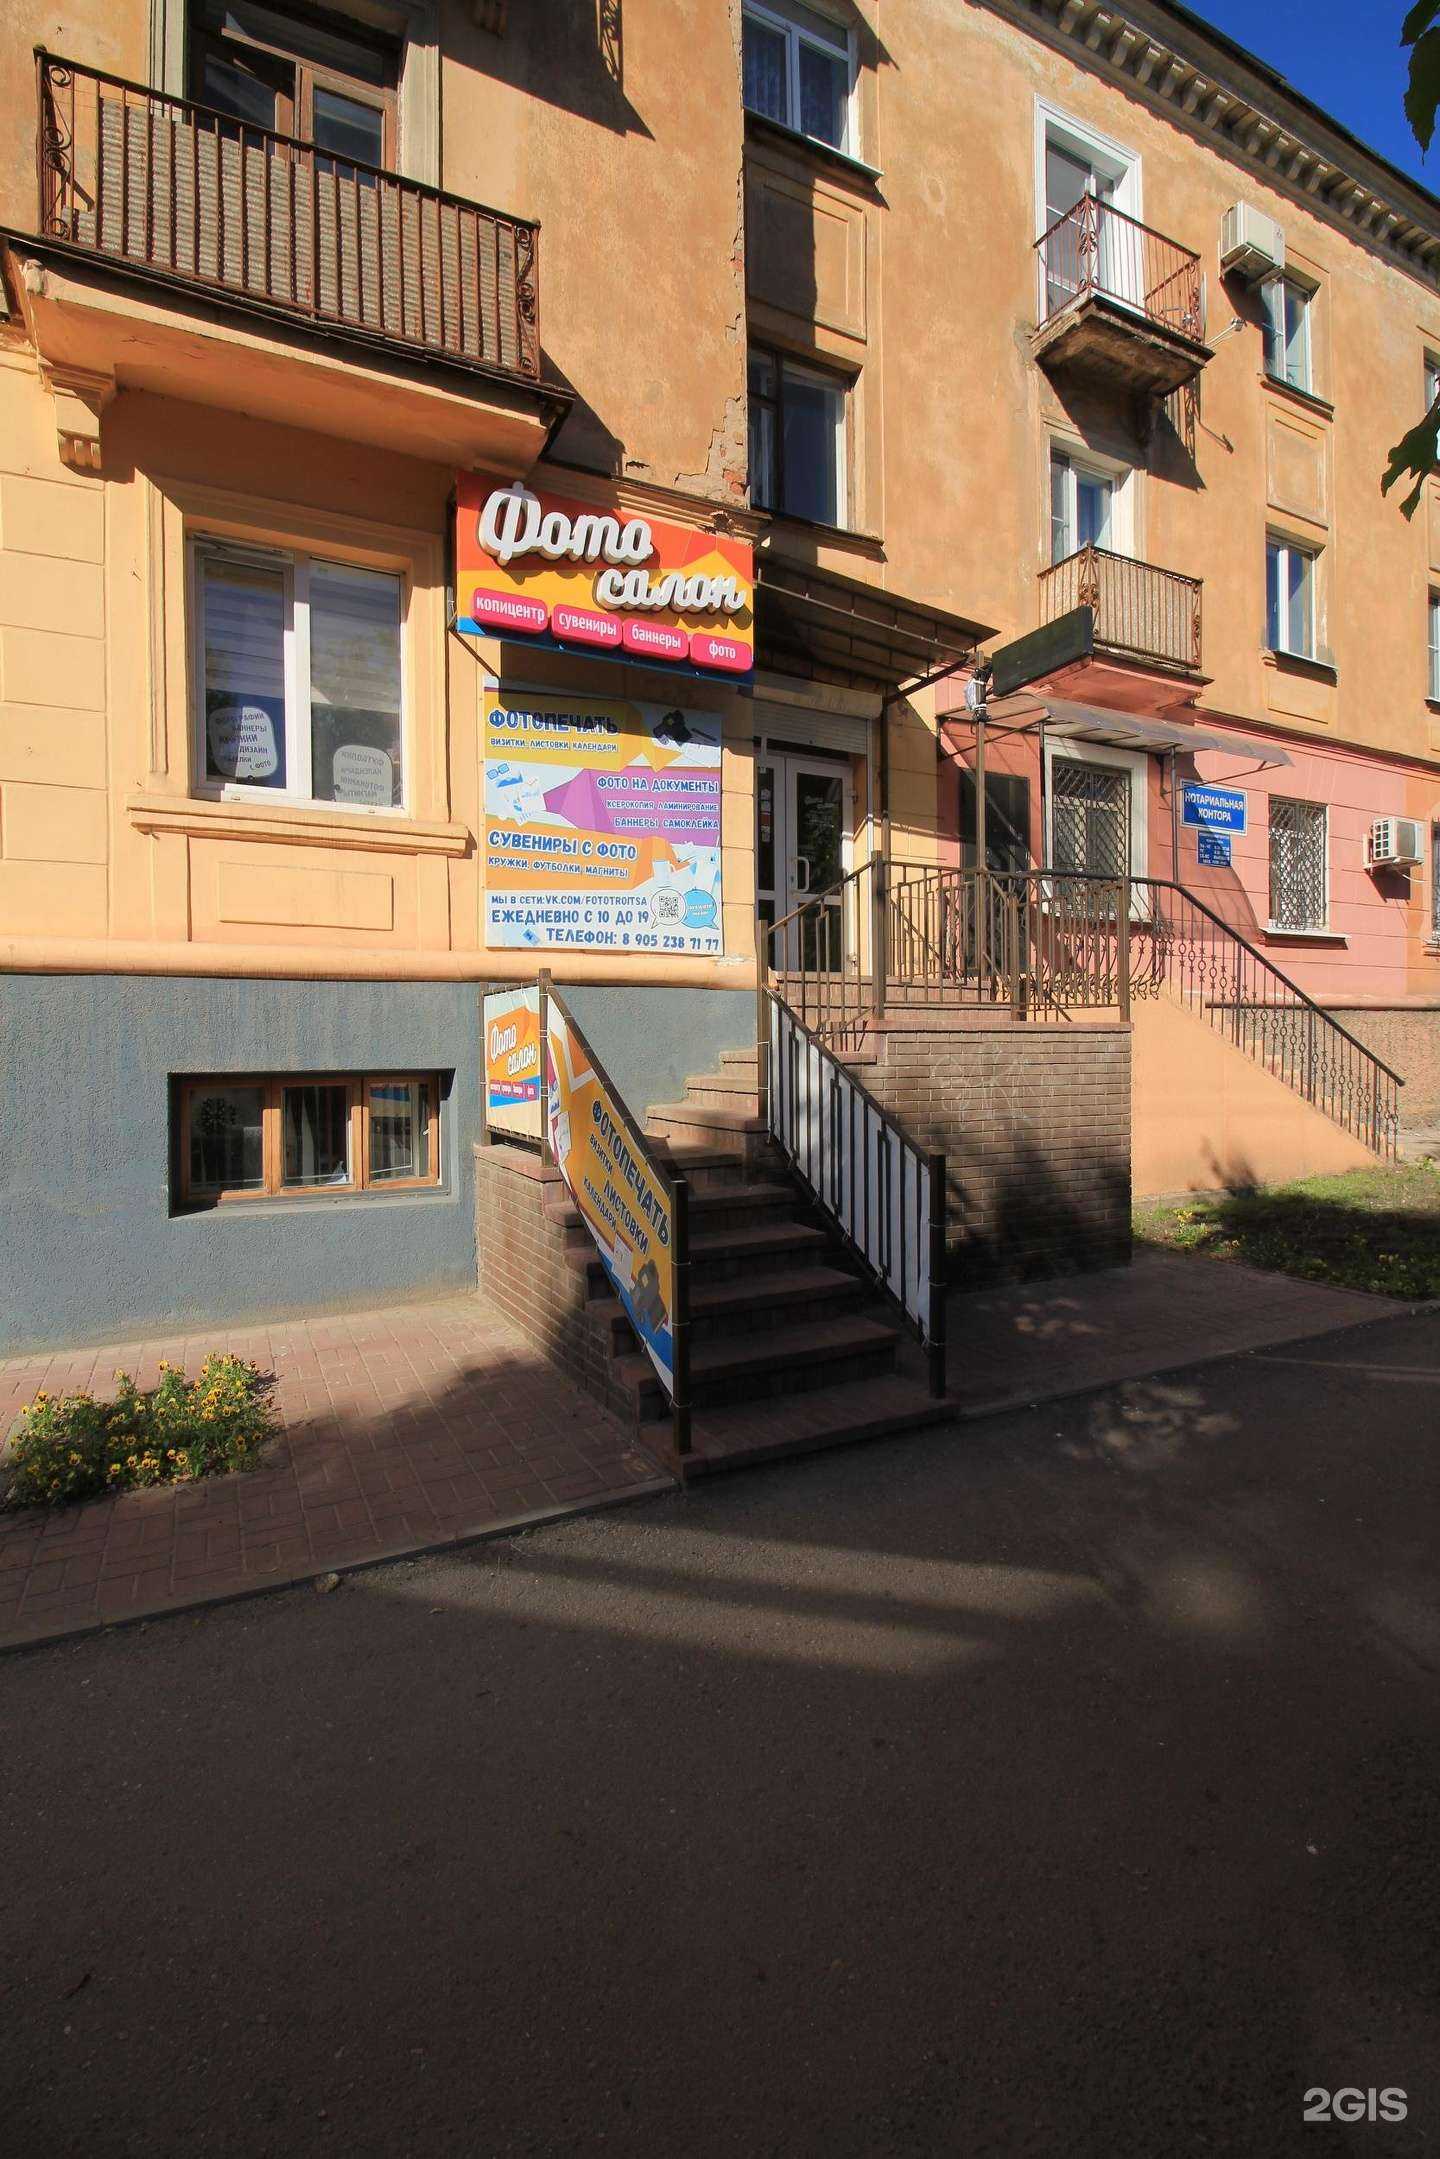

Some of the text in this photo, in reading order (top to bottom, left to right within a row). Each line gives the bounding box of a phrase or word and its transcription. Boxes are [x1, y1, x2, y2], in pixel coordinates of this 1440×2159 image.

[478, 481, 653, 565] Фото
[594, 568, 746, 614] салон
[476, 596, 545, 625] копицентр
[558, 611, 617, 638] сувениры
[631, 624, 682, 649] баннеры
[708, 640, 737, 660] фото
[489, 709, 619, 735] ФОТОПЕЧАТЬ
[573, 743, 618, 752] КАЛЕНДАРИ
[597, 777, 719, 793] ФОТО НА ДОКУМЕНТЫ
[658, 802, 718, 811] ЛАМИНИРОВАНИЕ
[1185, 792, 1244, 811] НОТАРИАЛЬНАЯ
[664, 817, 719, 829] САМОКЛЕЙКА
[1198, 807, 1232, 822] КОНТОРА
[489, 831, 637, 860] СУВЕНИРЫ С ФОТО
[585, 866, 629, 877] МАГНИТЫ
[491, 896, 507, 904] МЫ
[510, 896, 516, 904] В
[491, 909, 649, 925] ЕЖЕДНЕВНО С 10 ДО 19
[546, 927, 719, 951] ТЕЛЕФОН: 8 905 238 71 77
[590, 1133, 613, 1176] ВИЗИТКИ
[592, 1100, 670, 1247] ФОТОПЕЧАТЬ
[583, 1176, 618, 1232] КАЛЕНДАРИ
[603, 1179, 649, 1257] ЛИСТОВКИ
